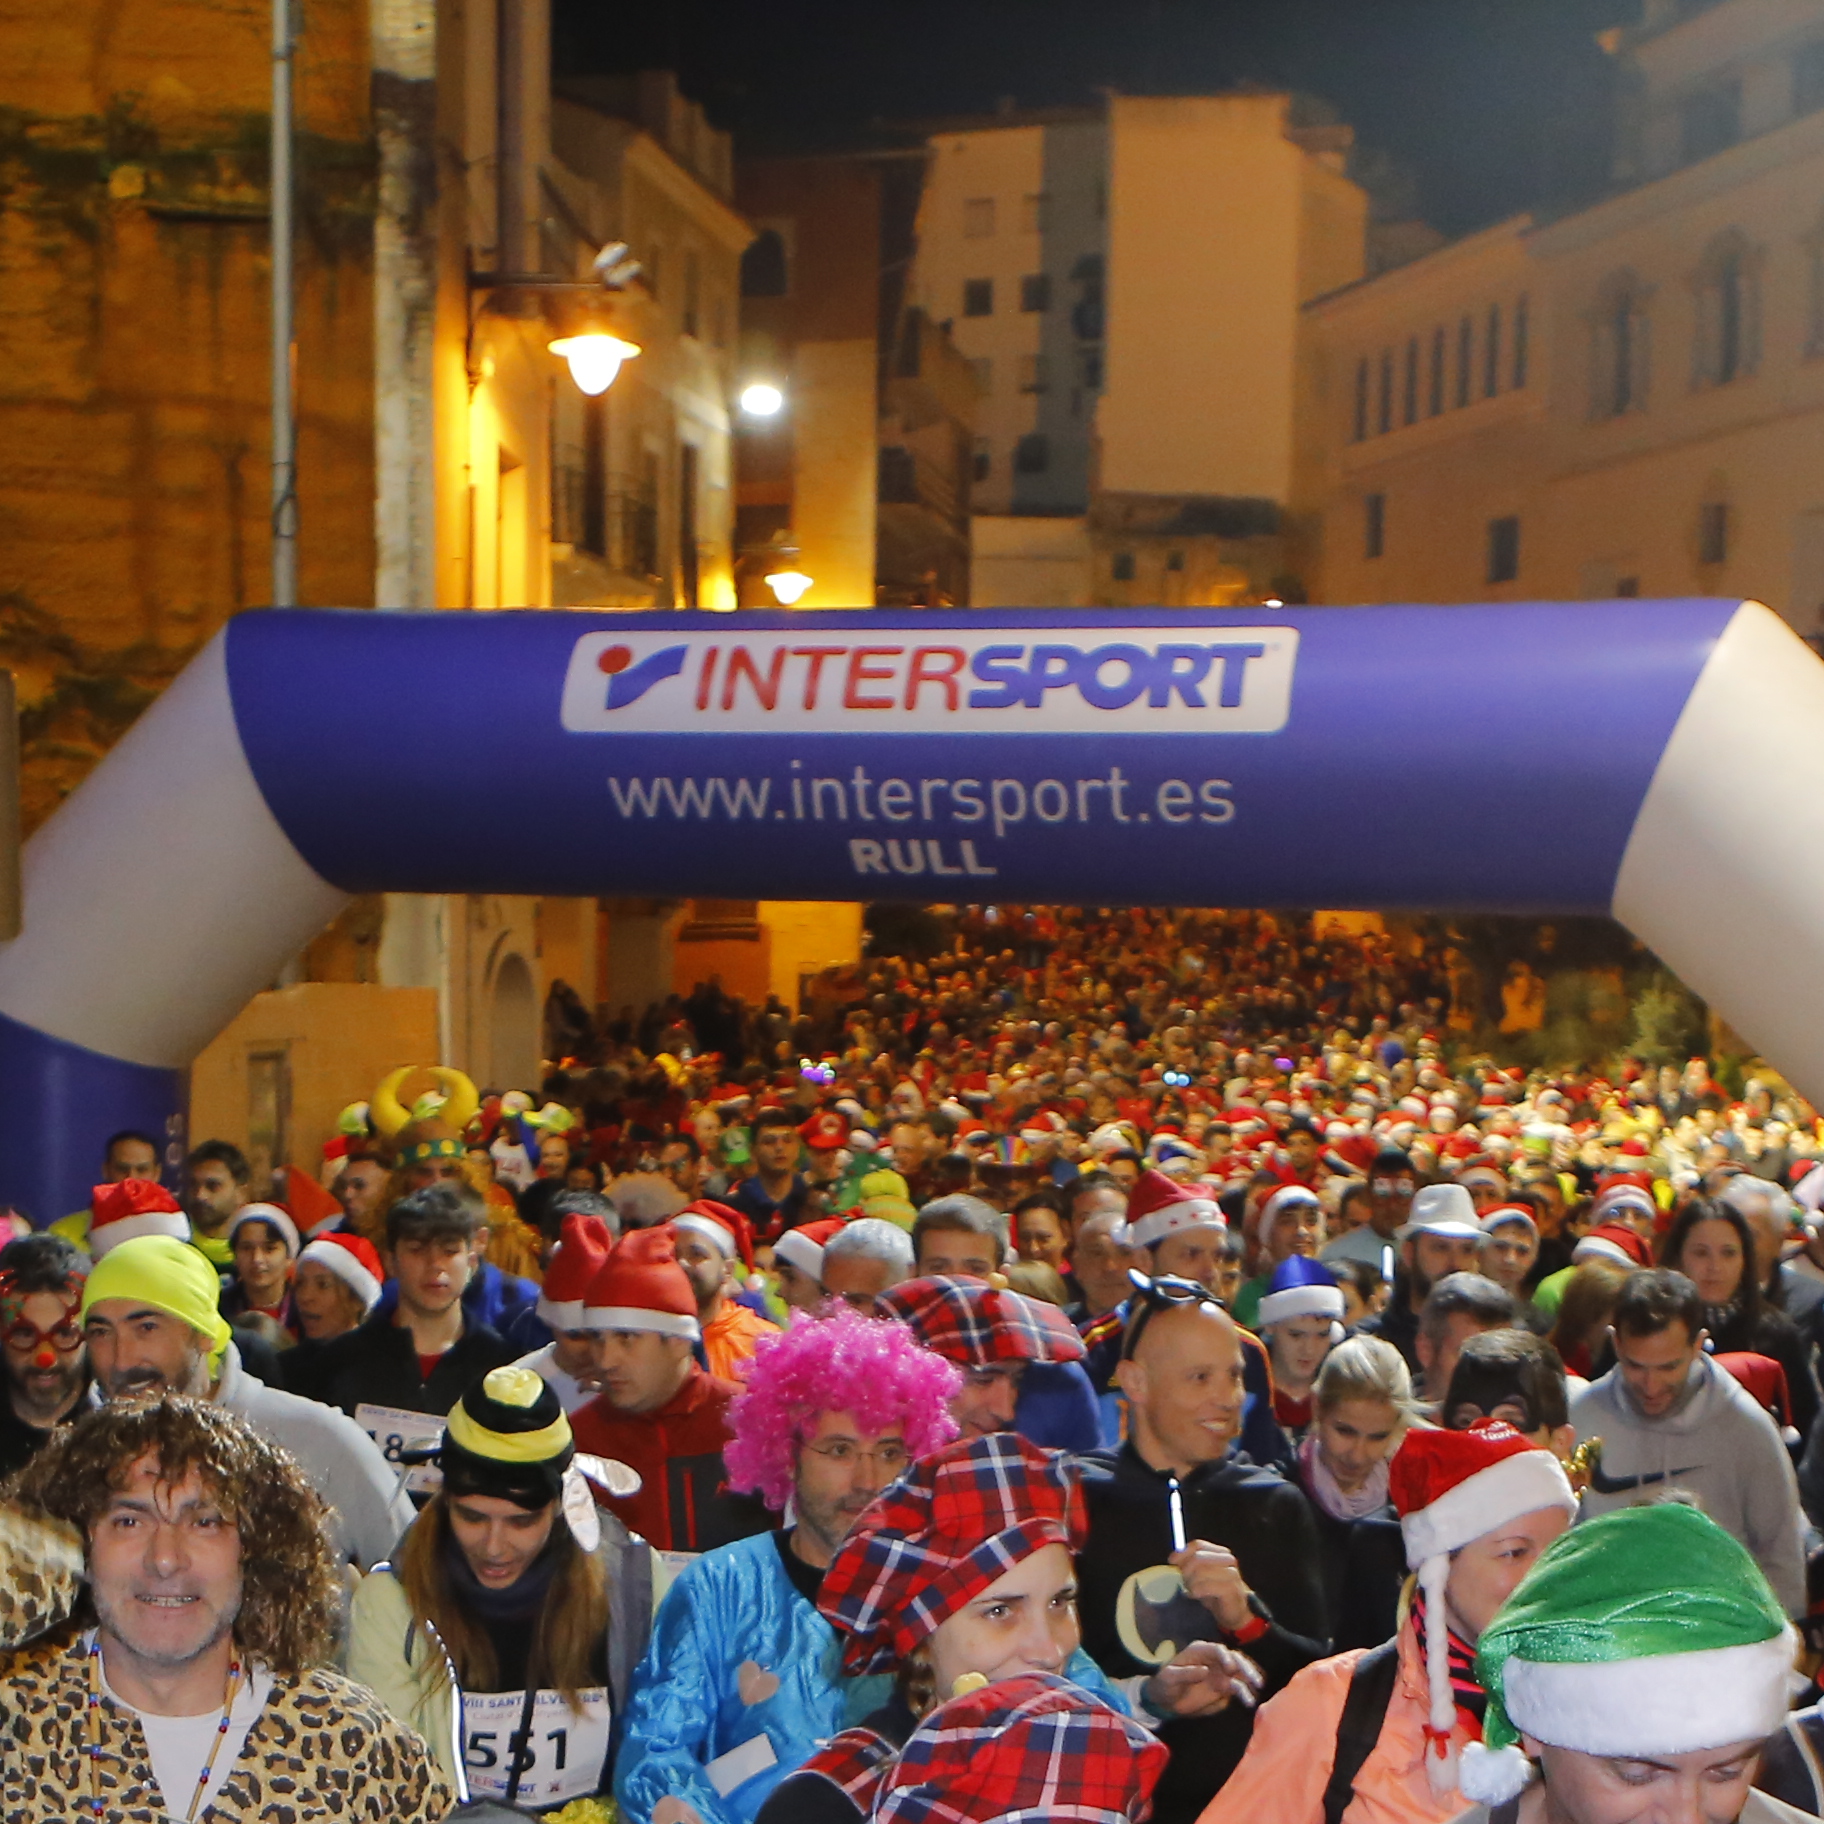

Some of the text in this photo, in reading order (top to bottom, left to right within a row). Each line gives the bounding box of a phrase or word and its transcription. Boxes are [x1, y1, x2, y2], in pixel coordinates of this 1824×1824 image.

[694, 643, 1265, 711] INTERSPORT
[609, 760, 1236, 835] www.intersport.es
[850, 838, 997, 875] RULL
[488, 1695, 523, 1709] SANT
[466, 1727, 567, 1772] 551
